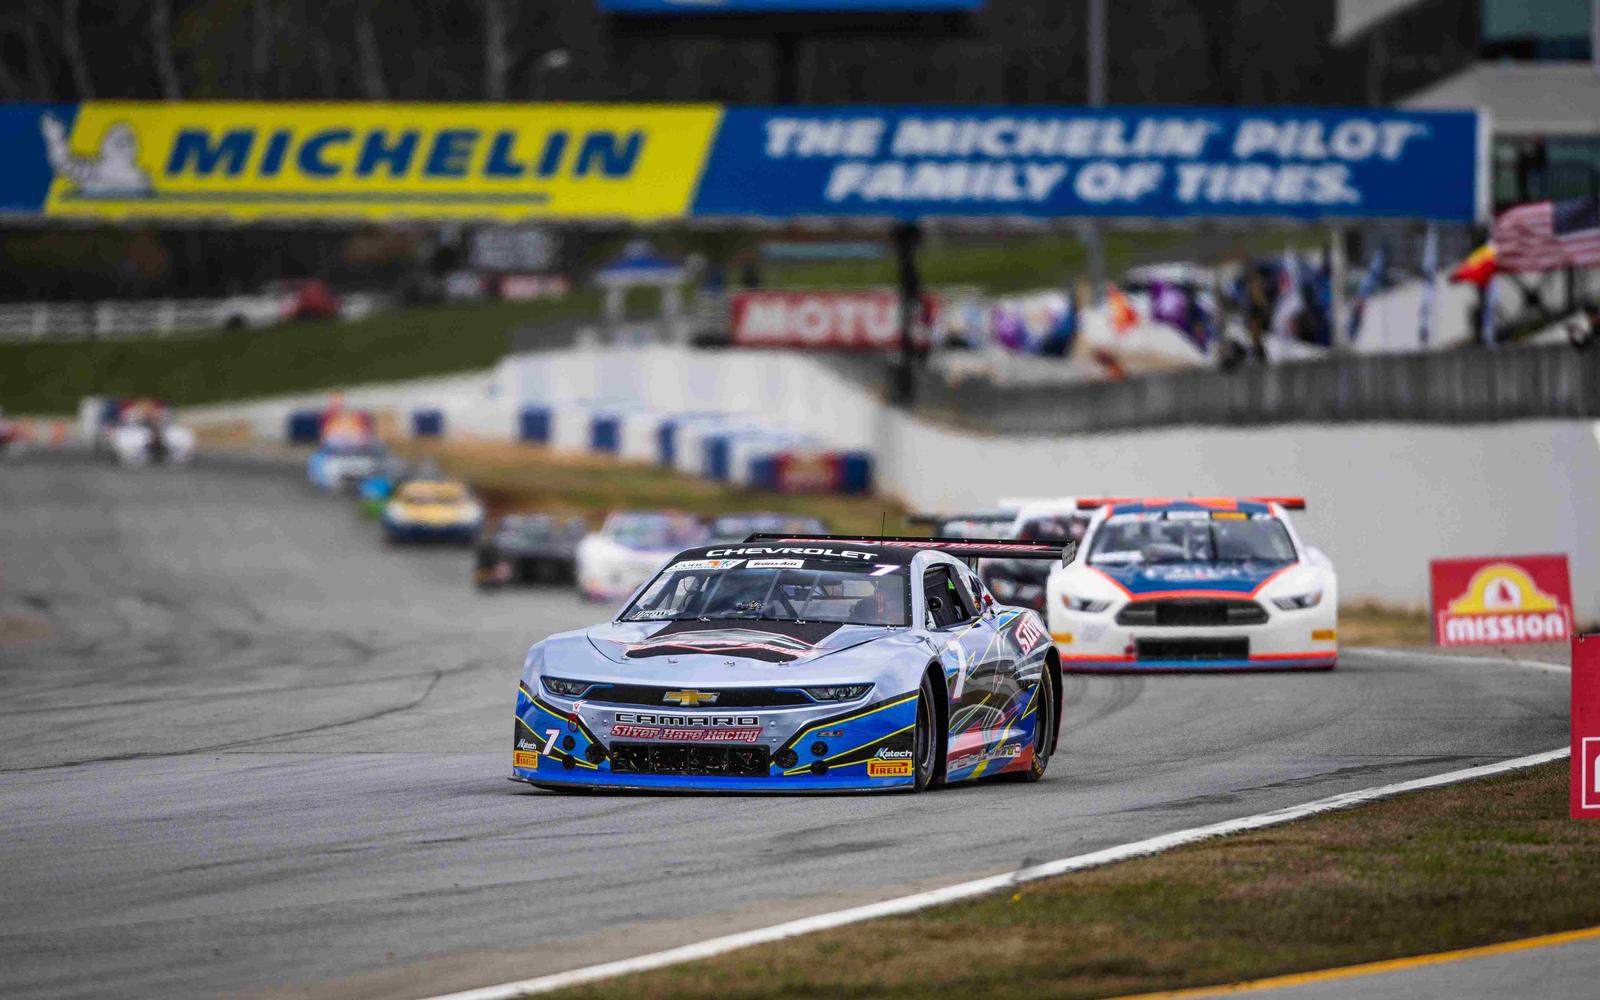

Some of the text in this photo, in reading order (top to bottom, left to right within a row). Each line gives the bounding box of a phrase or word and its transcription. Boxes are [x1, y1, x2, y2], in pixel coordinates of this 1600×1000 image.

[765, 117, 1416, 161] THE MICHELIN PILOT
[164, 128, 646, 179] MICHELIN
[824, 161, 1069, 202] FAMILY
[1074, 160, 1163, 202] OF
[705, 547, 879, 561] CHEVROLET
[868, 563, 899, 577] 7
[1446, 611, 1564, 642] mission
[945, 639, 967, 700] 7
[614, 712, 760, 727] CAMARO
[542, 728, 560, 755] 7
[610, 725, 762, 743] Silver Hare Racing
[516, 752, 537, 766] PIRELLI
[874, 747, 913, 760] Katech
[869, 762, 909, 775] PIRELLI
